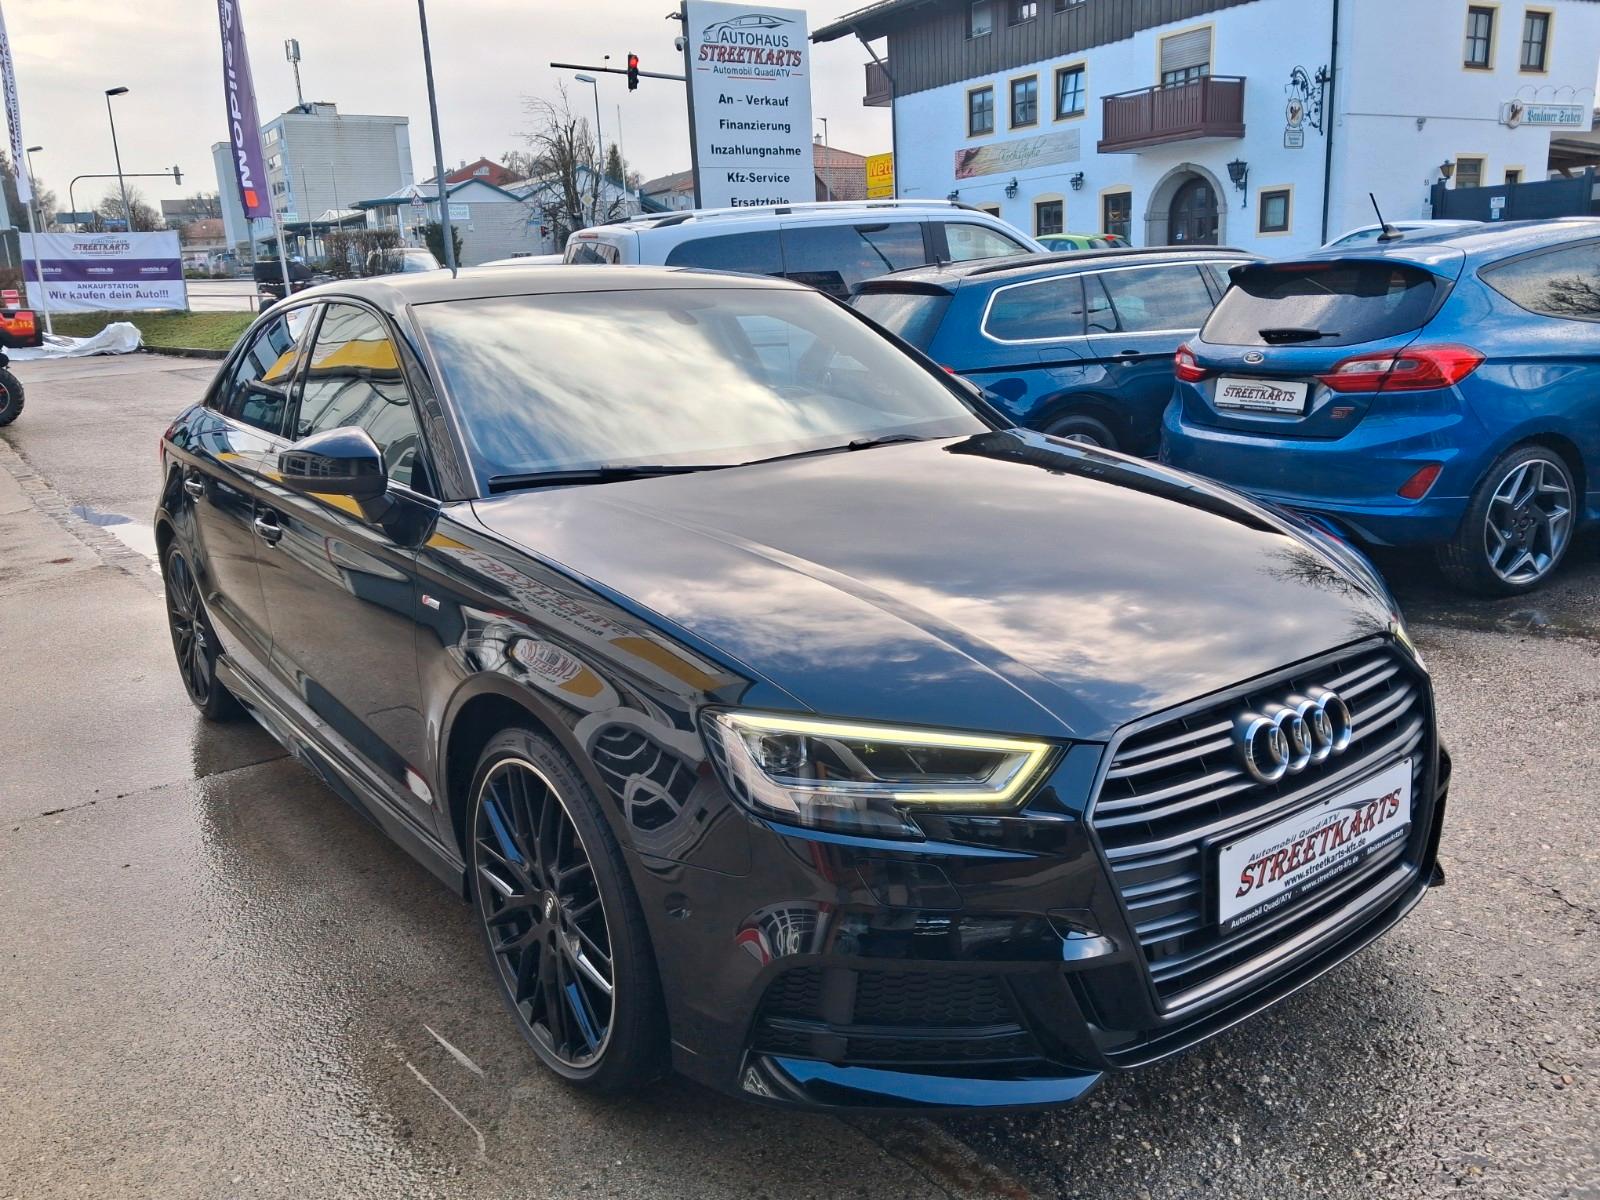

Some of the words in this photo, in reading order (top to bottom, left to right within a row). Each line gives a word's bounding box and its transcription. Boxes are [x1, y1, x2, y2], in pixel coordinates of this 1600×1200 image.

[720, 32, 789, 48] AUTOHAUS
[698, 44, 802, 67] STREETKARTS
[713, 66, 752, 75] Automobil
[754, 67, 790, 77] Quad/ATV
[718, 94, 733, 104] An
[746, 95, 789, 106] Verkauf
[720, 119, 791, 133] Finanzierung
[711, 144, 801, 157] Inzahlungnahme
[727, 173, 790, 183] Kfz-Service
[49, 291, 66, 299] Wir
[70, 291, 105, 299] kaufen
[109, 290, 133, 299] dein
[135, 290, 169, 299] Auto!!!
[1224, 386, 1296, 402] STREETKARTS
[1236, 788, 1402, 898] STREETKARTS
[1249, 833, 1297, 862] Automobil
[1299, 812, 1340, 840] Quad/ATV
[1284, 837, 1366, 887] www.streetkarts-kfz.de
[1231, 906, 1262, 928] Automobil
[1264, 892, 1292, 912] Quad/ATV
[1302, 856, 1359, 892] www.streetkarts-kfz.de
